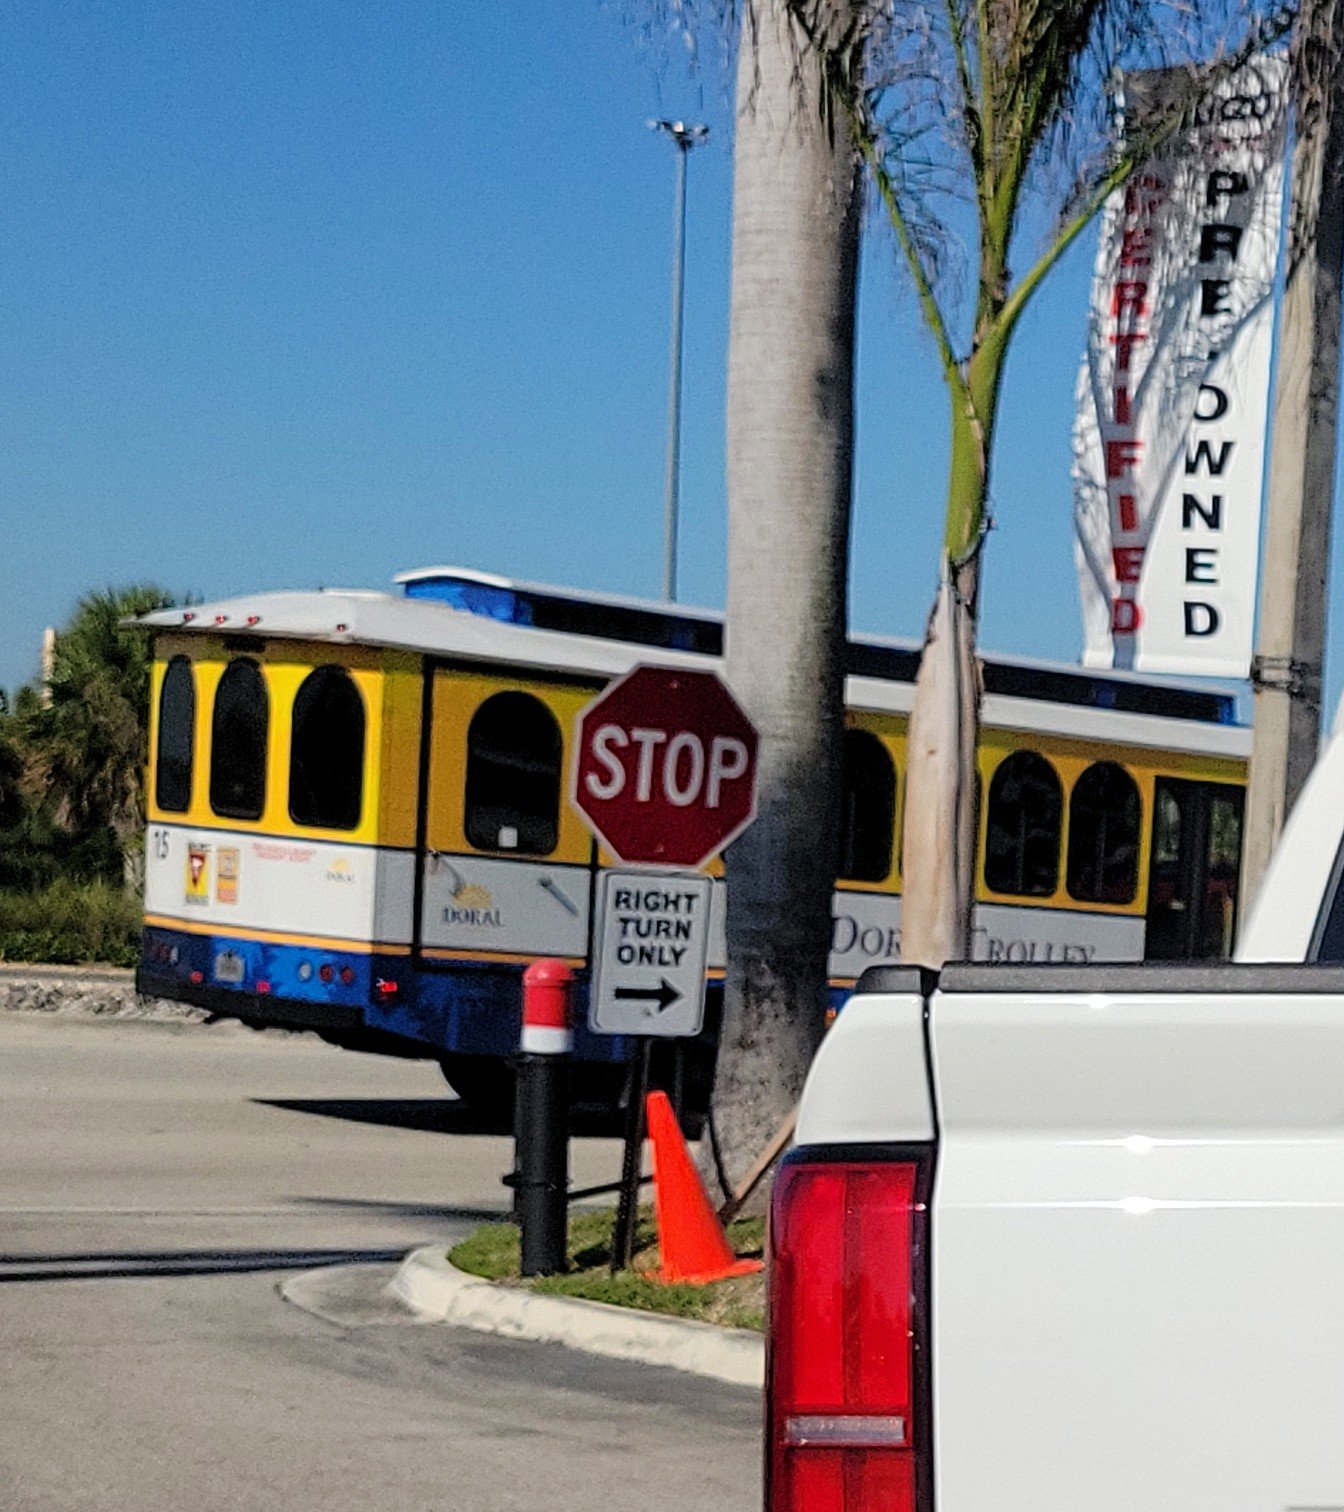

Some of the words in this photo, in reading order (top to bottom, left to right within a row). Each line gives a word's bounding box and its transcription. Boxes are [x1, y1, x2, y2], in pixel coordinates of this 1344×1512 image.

[586, 723, 750, 809] STOP
[614, 890, 700, 914] RIGHT
[618, 917, 693, 940] TURN
[617, 944, 687, 967] ONLY
